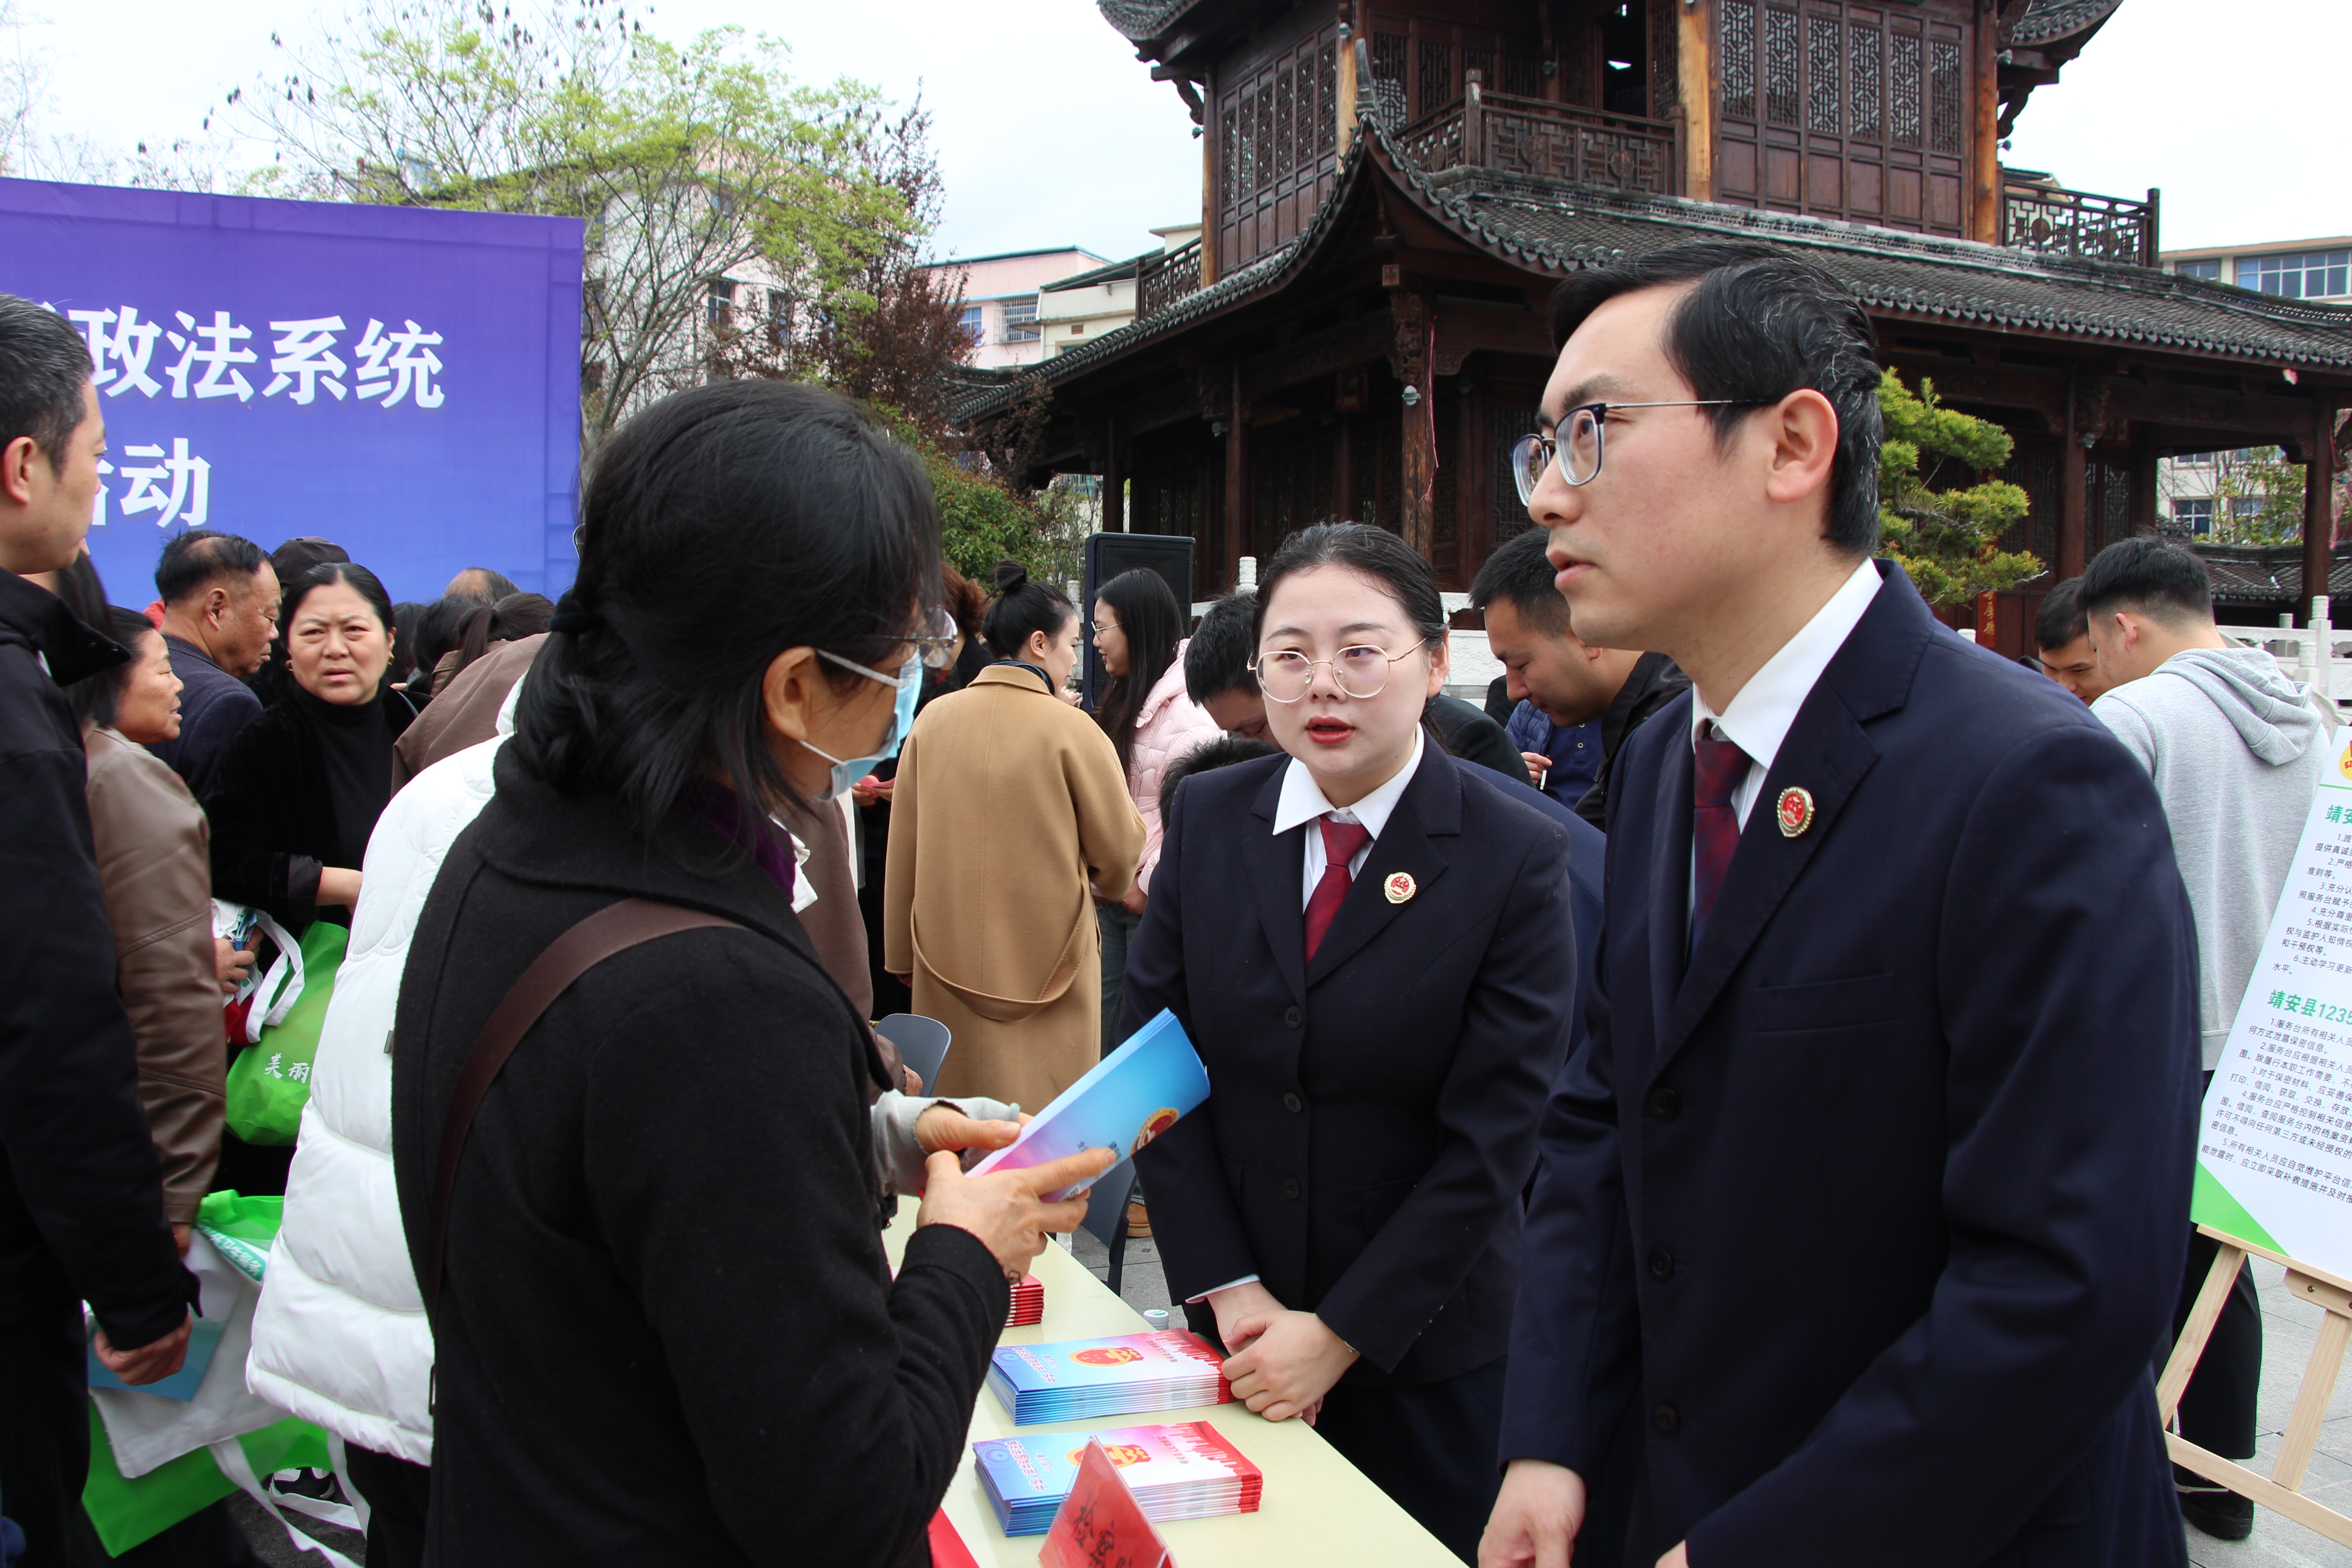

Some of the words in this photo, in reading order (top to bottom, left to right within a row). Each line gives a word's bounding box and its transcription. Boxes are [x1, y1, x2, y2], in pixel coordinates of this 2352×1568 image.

[42, 302, 445, 408] 政法系统
[2337, 833, 2352, 843] 1.践
[2306, 866, 2335, 879] 准则等。
[2281, 938, 2326, 956] 和干预权等。
[2272, 962, 2292, 975] 水平。
[2267, 990, 2352, 1025] 靖安县1235
[2248, 1025, 2328, 1054] 何方式泄露保密信息。
[264, 1052, 310, 1084] 美丽
[2239, 1049, 2352, 1088] 围。除履行本职工作需要，不
[2210, 1120, 2238, 1137] 密信息。
[2222, 1138, 2352, 1189] 5.所有相关人员应自觉维护平台信
